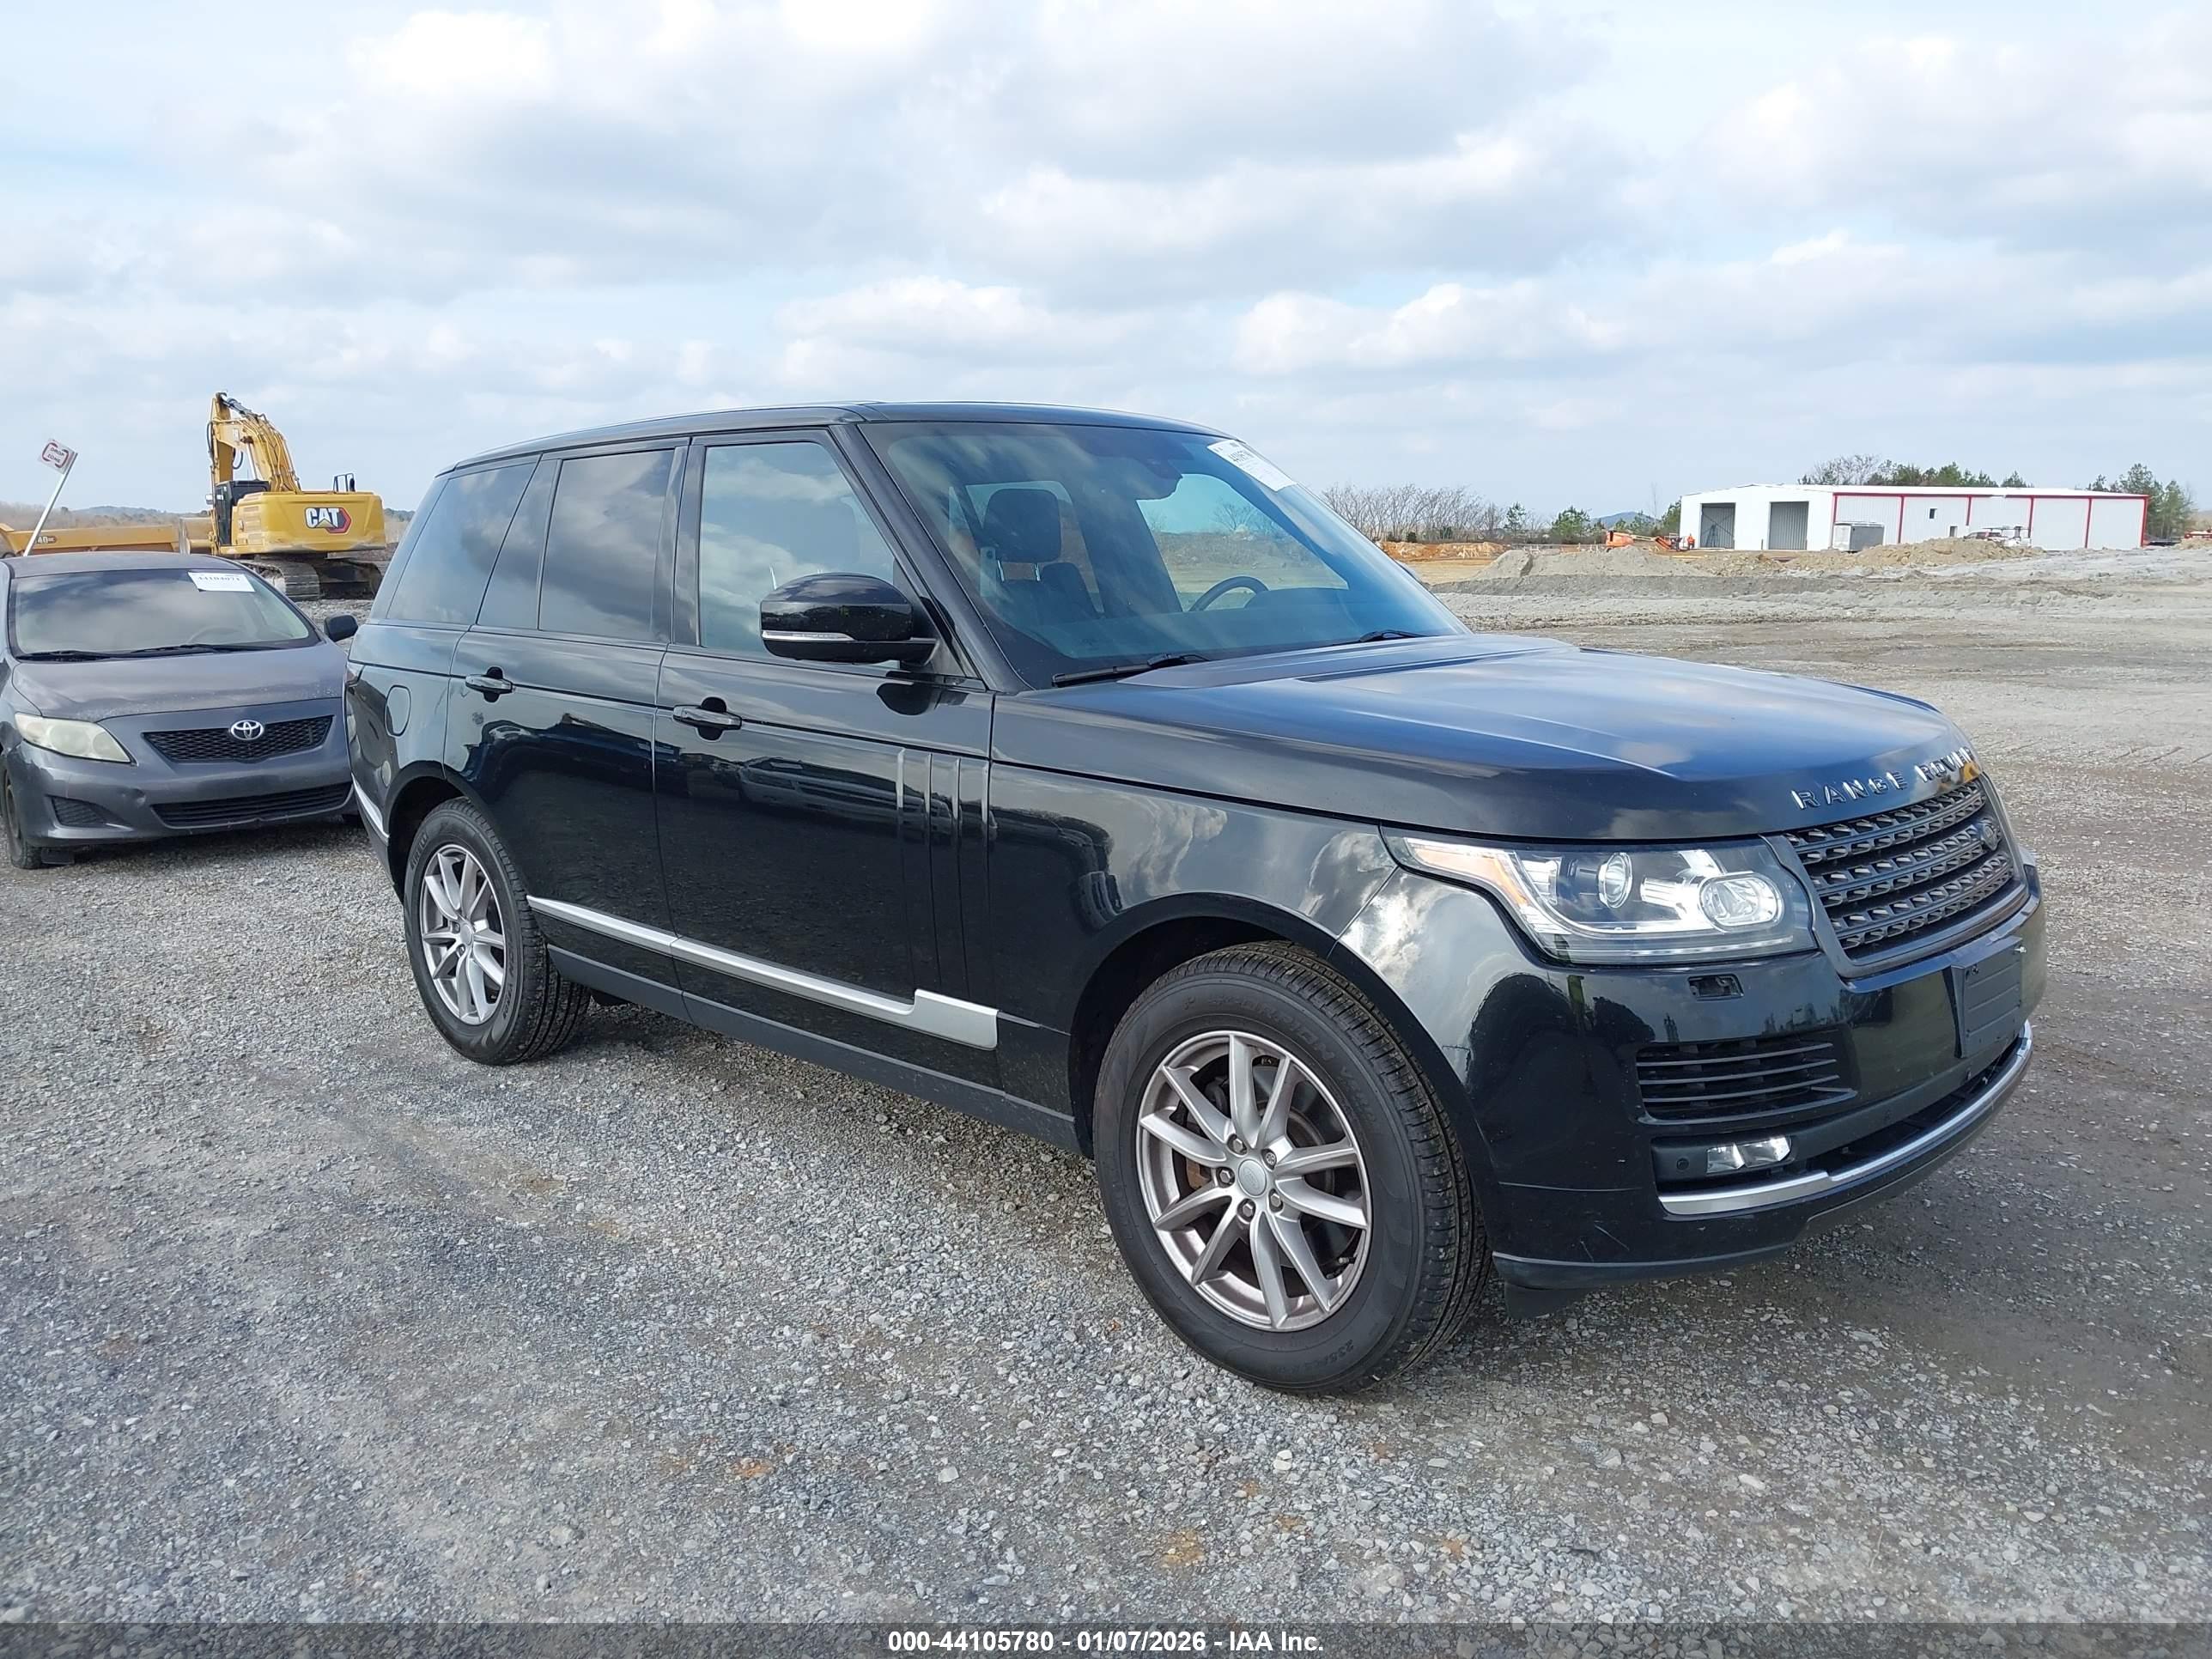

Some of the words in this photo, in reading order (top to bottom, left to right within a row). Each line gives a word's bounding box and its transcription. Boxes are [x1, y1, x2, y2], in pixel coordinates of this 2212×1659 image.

[305, 507, 340, 528] CAT
[1790, 771, 1907, 810] RANGE
[1914, 745, 1974, 782] ROVER
